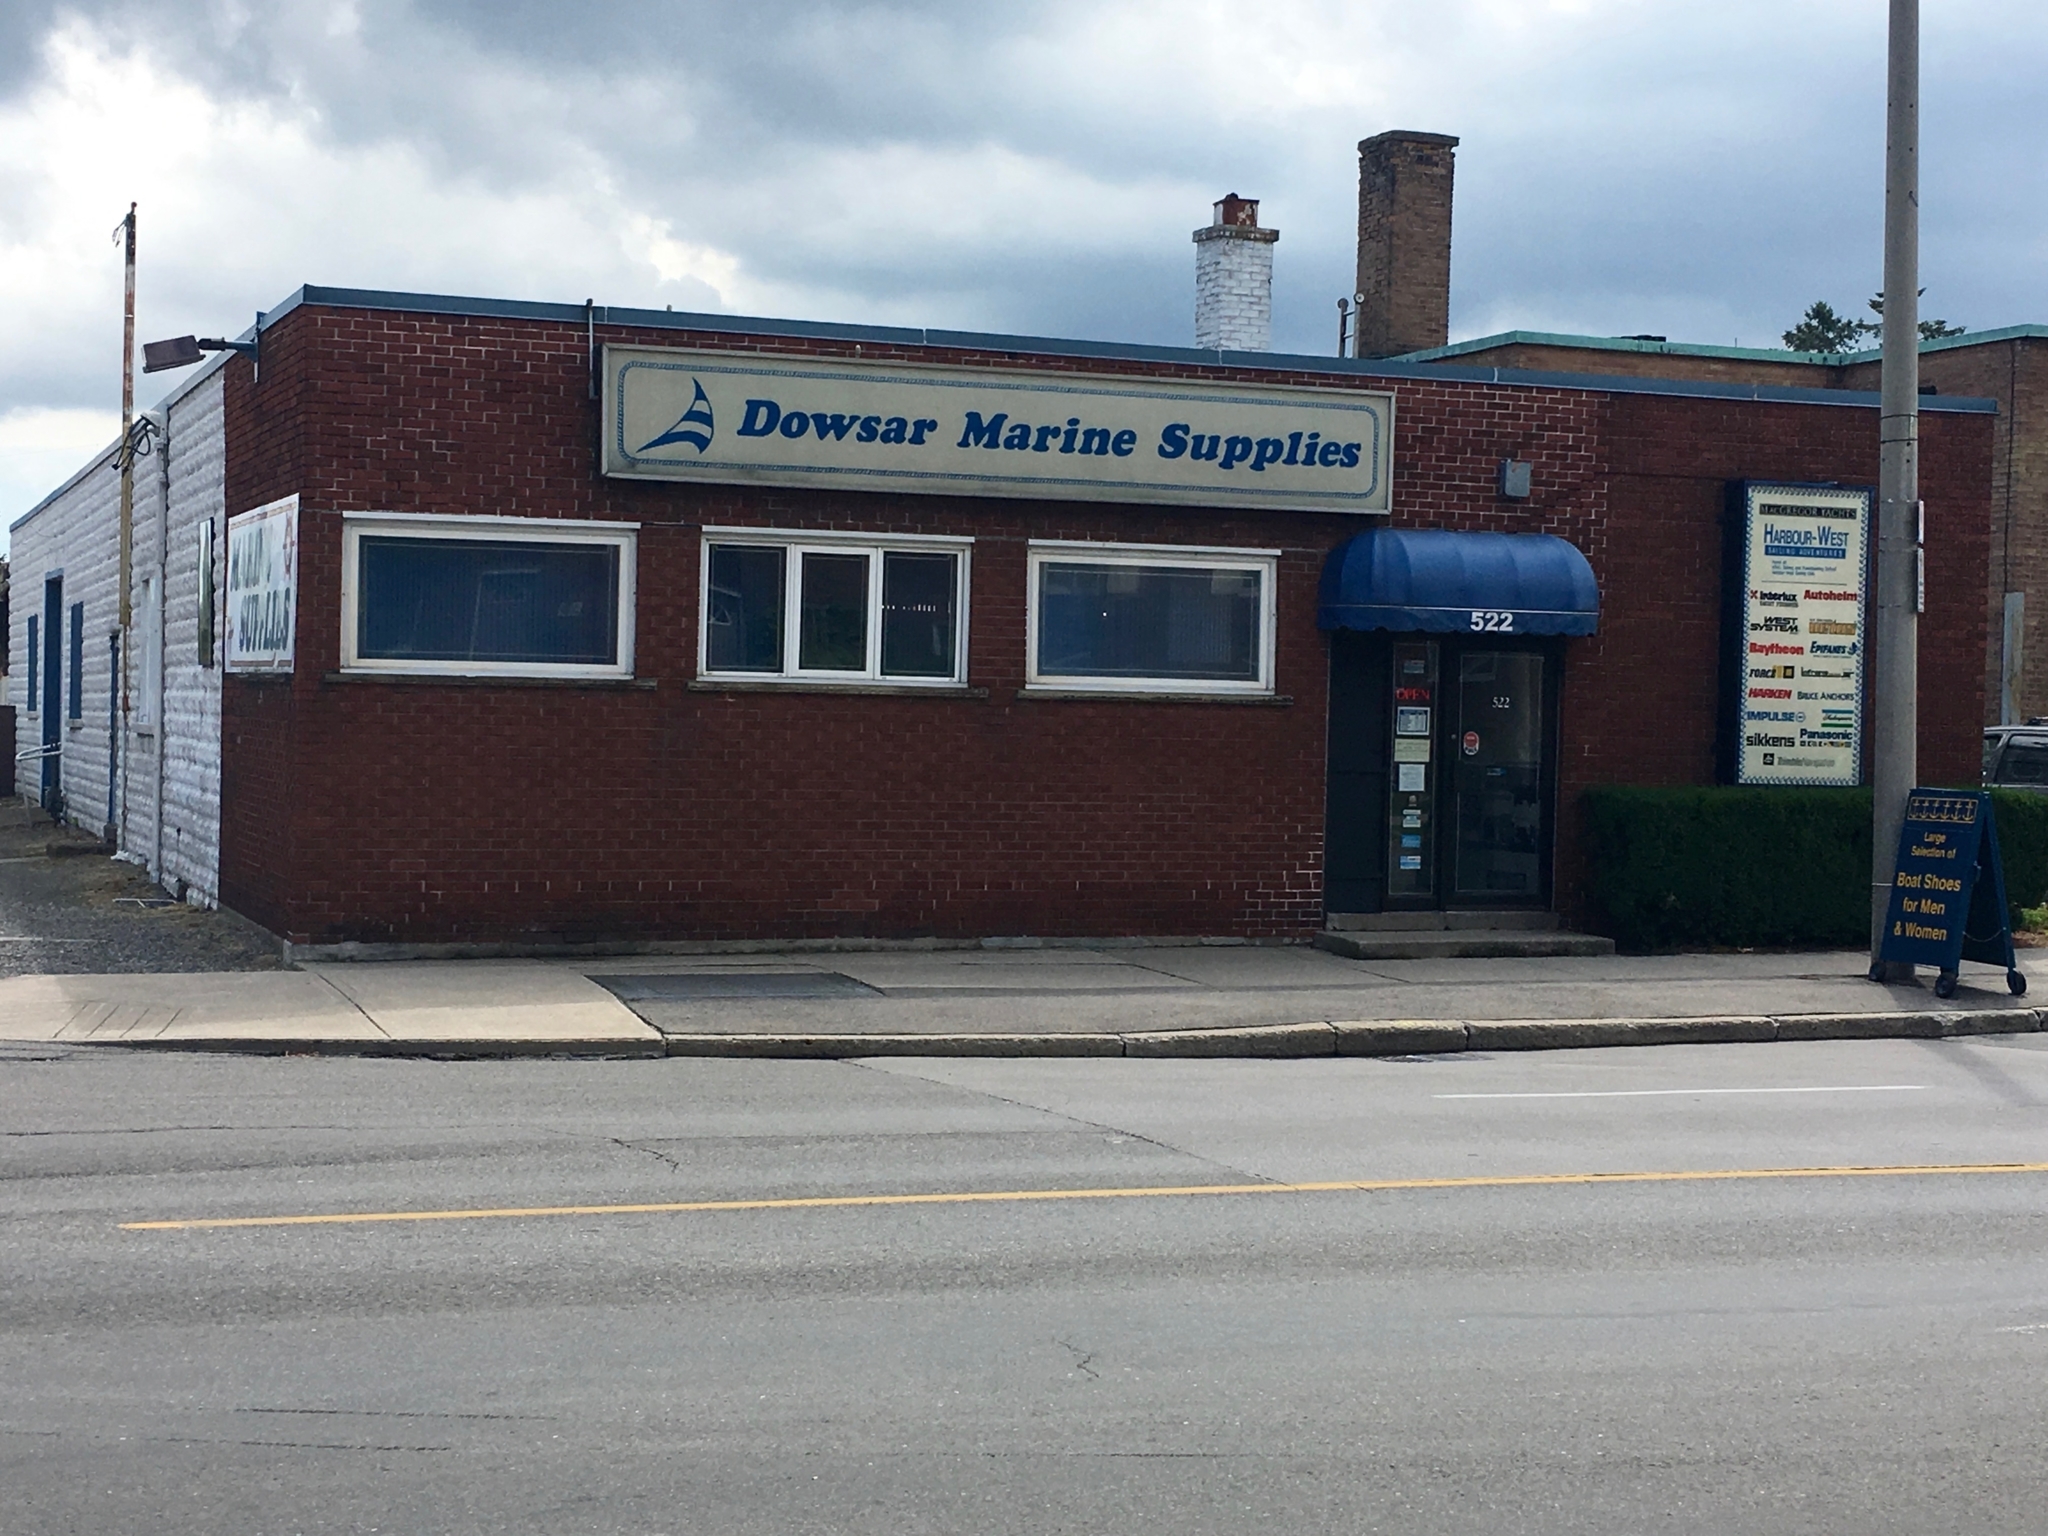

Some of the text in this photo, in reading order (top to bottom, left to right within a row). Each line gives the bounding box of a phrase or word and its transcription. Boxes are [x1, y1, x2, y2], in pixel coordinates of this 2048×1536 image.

[736, 398, 1361, 472] Dowsar Marine Supplies
[1763, 523, 1849, 547] HARBOUR-WEST
[1470, 612, 1514, 632] 522
[1763, 616, 1799, 625] WEST
[1750, 623, 1799, 633] SYSTEM
[1396, 687, 1431, 700] OPEN
[1748, 688, 1793, 699] HARKEN
[1492, 696, 1510, 709] 522
[1747, 711, 1795, 722] IMPULSE
[1746, 733, 1795, 747] sikkens
[1800, 728, 1853, 740] Panasonic
[1924, 832, 1946, 845] Large
[1911, 846, 1957, 859] Selection of
[1897, 872, 1961, 892] Boat Shoes
[1903, 897, 1945, 915] for Men
[1893, 921, 1947, 941] & Women
